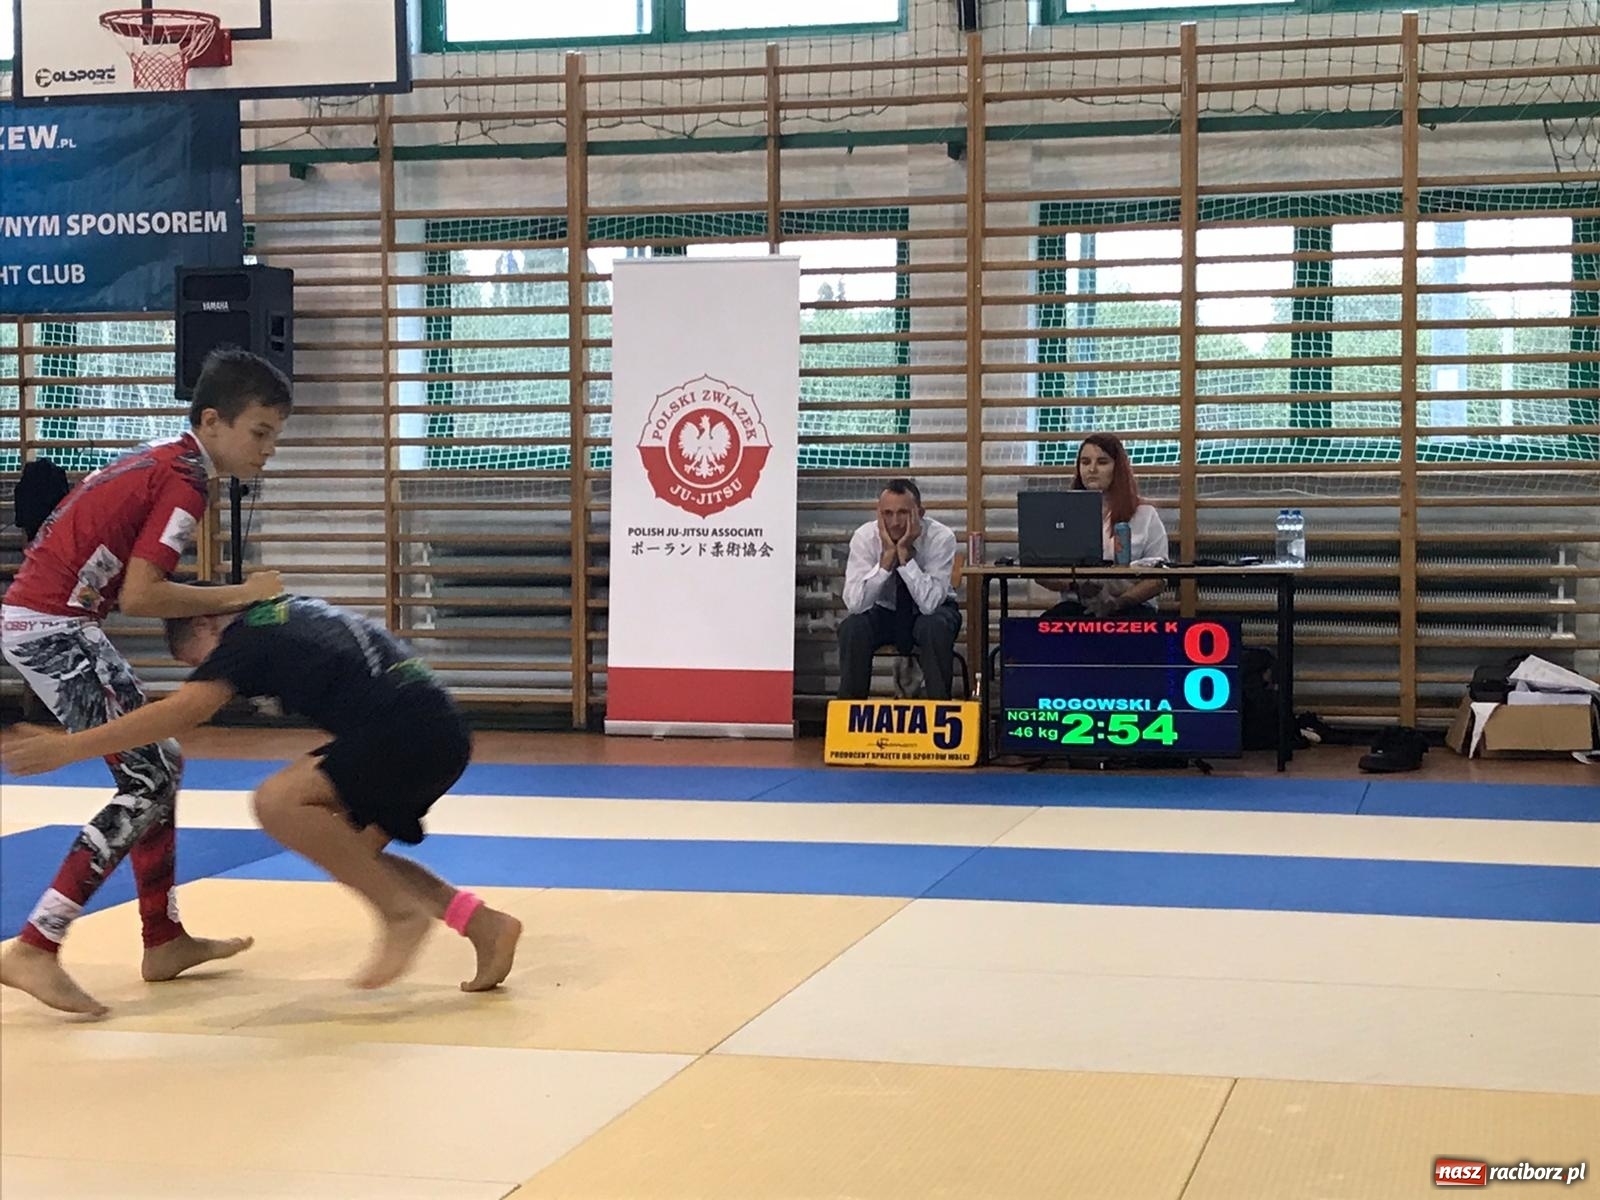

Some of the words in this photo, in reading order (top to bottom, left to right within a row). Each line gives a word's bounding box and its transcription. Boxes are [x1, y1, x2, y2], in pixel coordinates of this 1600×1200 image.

[0, 125, 76, 150] EW.PL
[0, 215, 60, 237] NYM
[67, 211, 227, 236] SPONSOREM
[27, 264, 86, 285] CLUB
[202, 301, 229, 311] YAMAHA
[652, 392, 696, 441] POLSKI
[702, 390, 757, 440] ZWIĄZEK
[669, 478, 743, 505] JU-JITSU
[628, 527, 665, 536] POLISH
[667, 527, 709, 537] JU-JITSU
[711, 527, 764, 537] ASSOCIATI
[1038, 621, 1158, 633] SZYMICZEK
[1165, 622, 1178, 633] K
[1184, 622, 1230, 664] 0
[1038, 698, 1151, 710] ROGOWSKI
[1157, 699, 1172, 710] A
[1184, 668, 1230, 710] 0
[848, 704, 928, 734] MATA
[933, 704, 963, 750] 5
[1007, 711, 1059, 721] NG12M
[1061, 713, 1178, 745] 2:54
[1008, 727, 1033, 738] -46
[1039, 727, 1058, 740] kg
